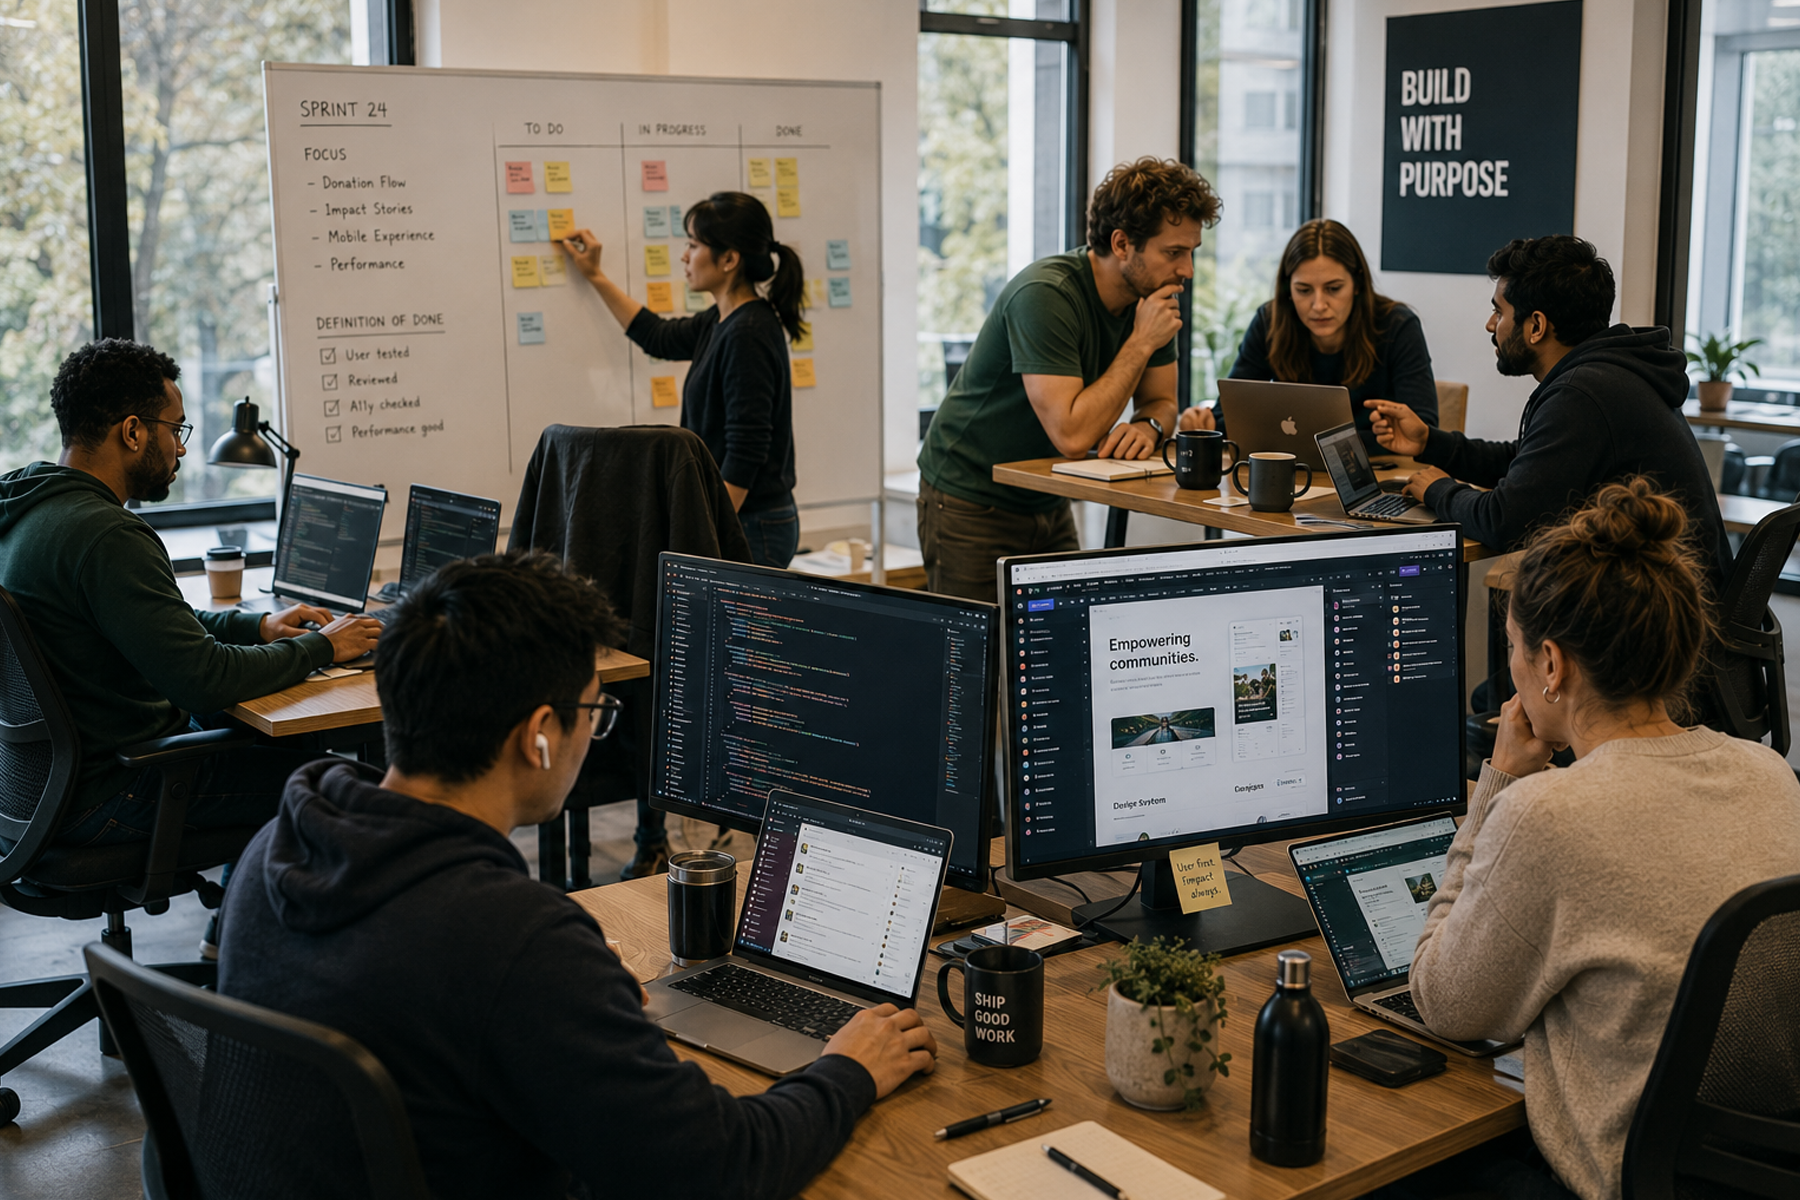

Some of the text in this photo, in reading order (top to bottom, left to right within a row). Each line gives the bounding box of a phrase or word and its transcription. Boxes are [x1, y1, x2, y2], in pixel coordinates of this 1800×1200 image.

[1402, 68, 1470, 106] BUILD
[300, 99, 388, 118] SPRINT 24
[524, 121, 564, 135] TO DO
[639, 123, 706, 136] IN PROGRESS
[776, 125, 802, 137] DONE
[1401, 114, 1461, 151] WITH
[304, 147, 347, 161] FOCUS
[322, 174, 406, 190] Donation Flow
[1400, 161, 1509, 197] PURPOSE
[325, 201, 413, 220] Impact Stories
[328, 228, 435, 246] Mobile Experience
[330, 256, 405, 271] Performance
[316, 313, 443, 331] DEFINITION OF DONE
[345, 347, 410, 362] User tested
[348, 372, 398, 386] Reviewed
[379, 397, 421, 410] checked
[351, 419, 445, 438] Performance good
[1109, 632, 1192, 653] Empowering
[1109, 651, 1199, 670] communities.
[975, 992, 1005, 1009] SHIP
[975, 1010, 1009, 1025] GOOD
[976, 1024, 1015, 1042] WORK
